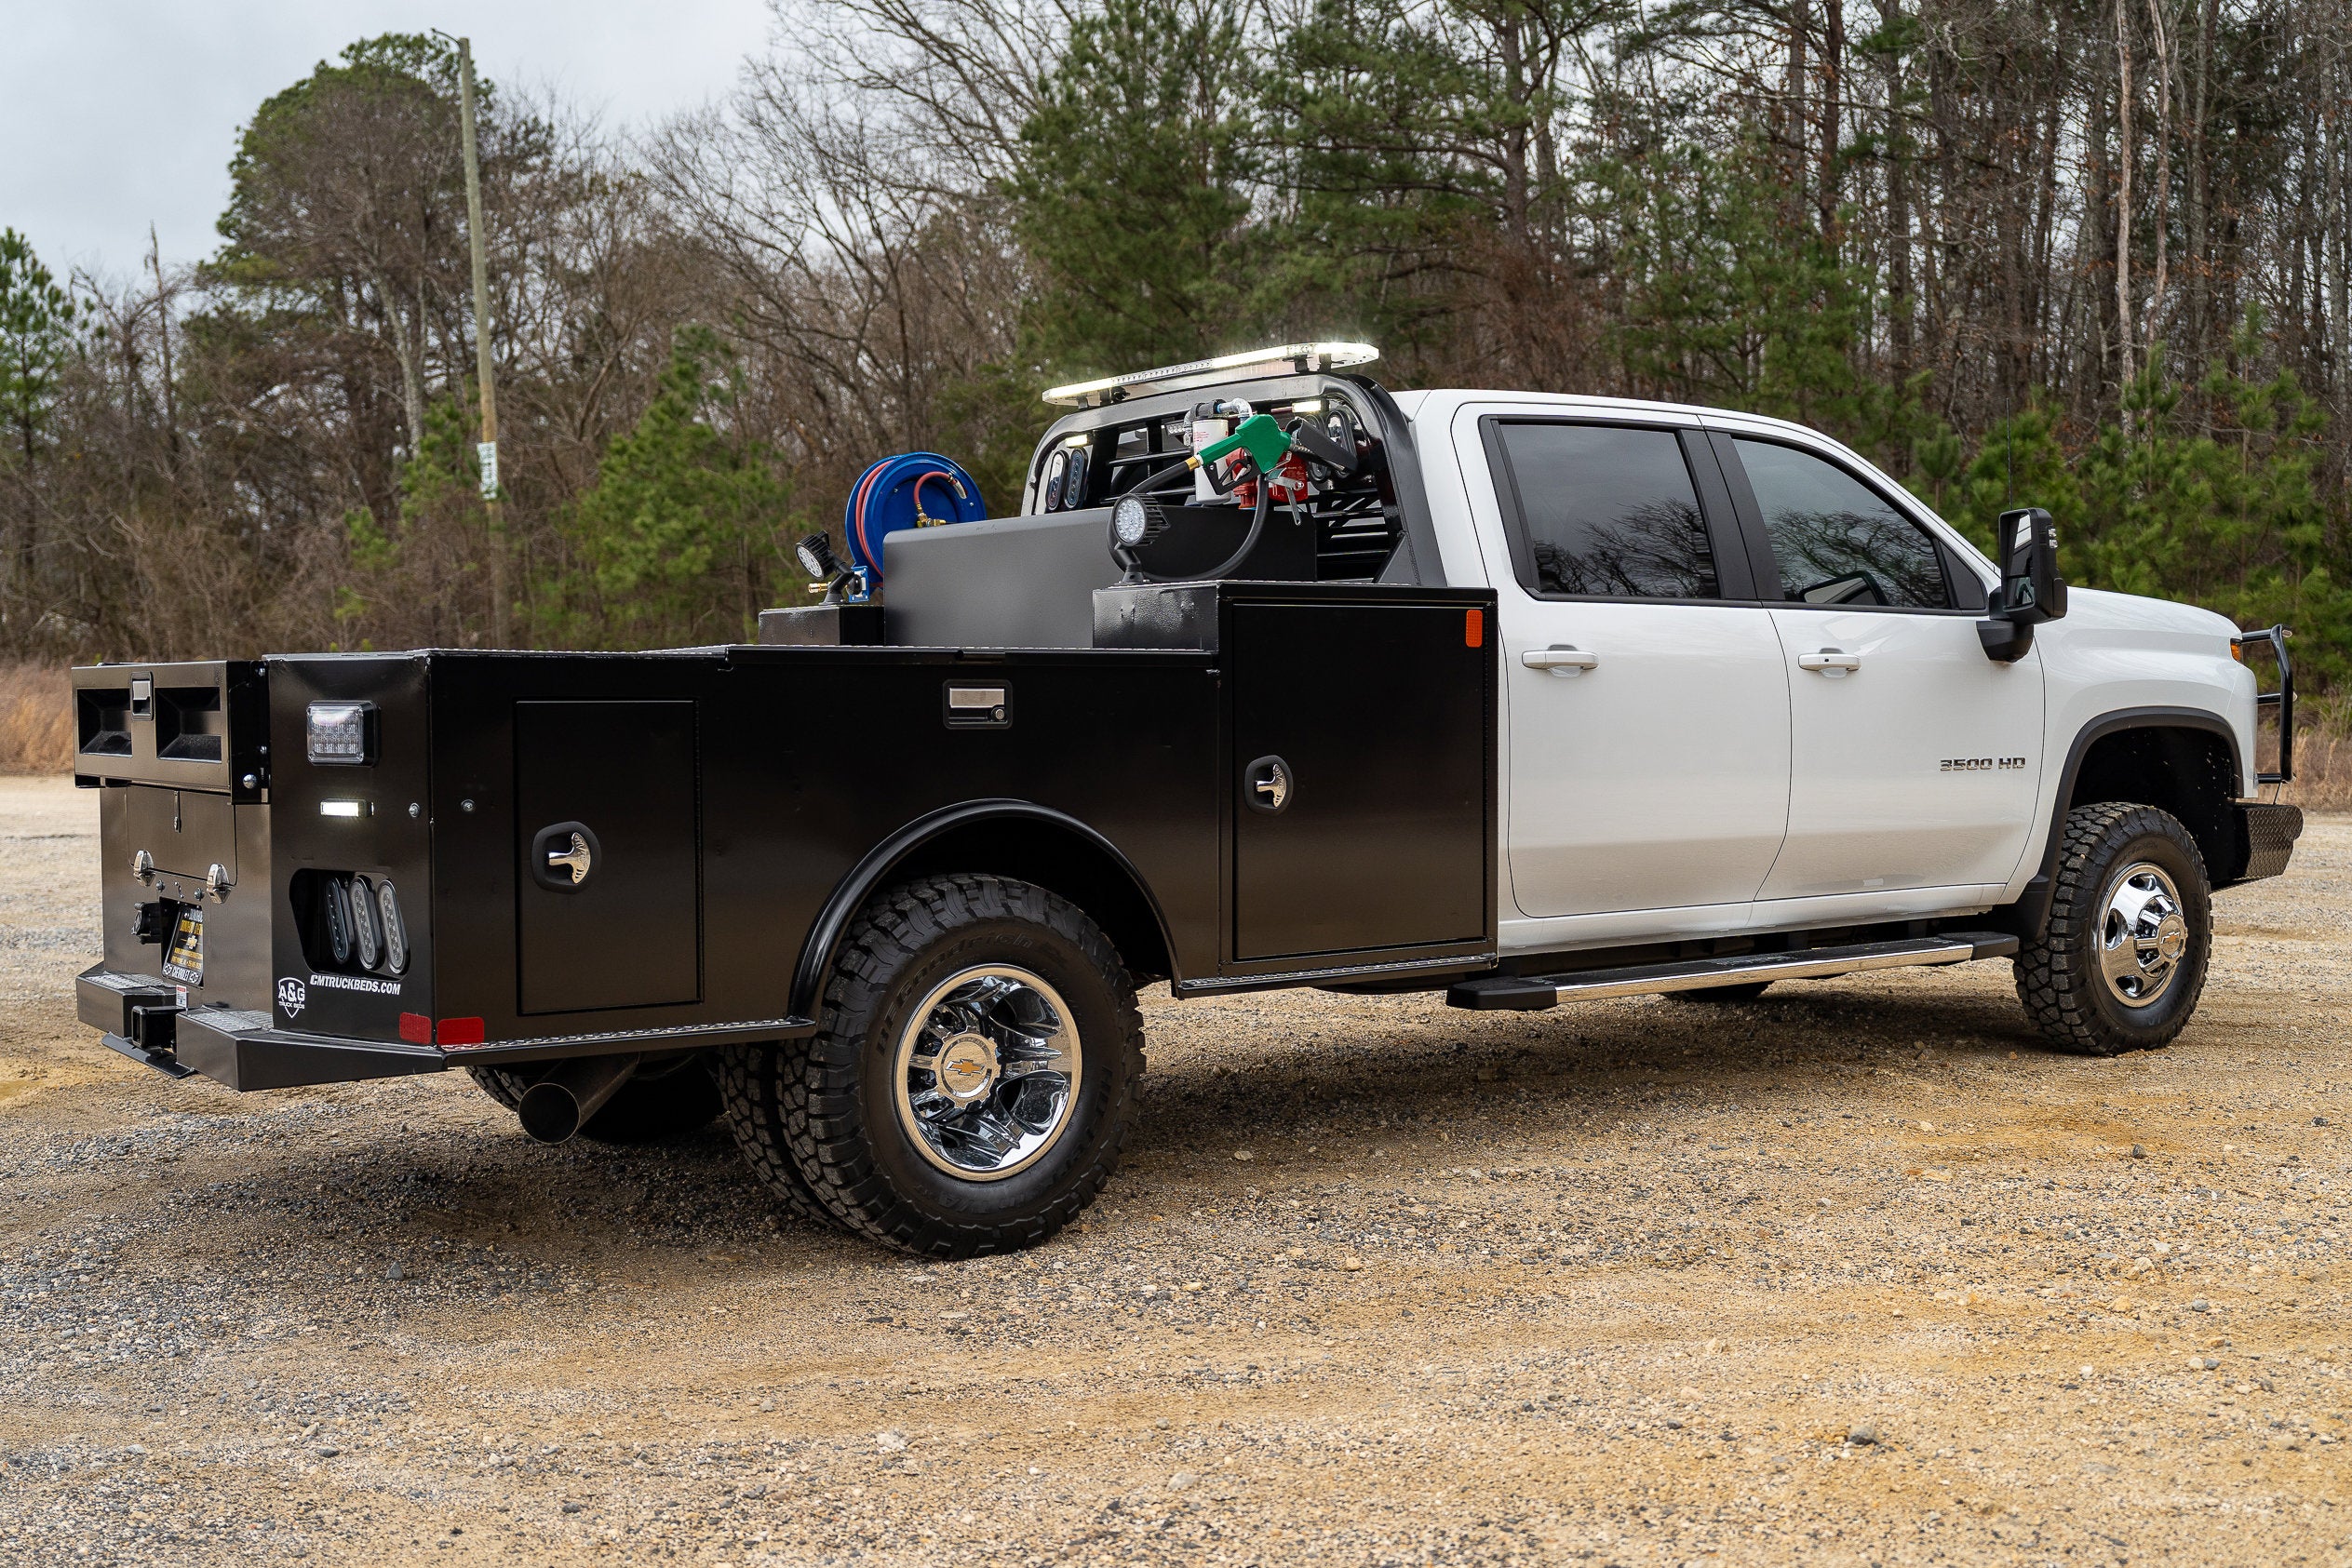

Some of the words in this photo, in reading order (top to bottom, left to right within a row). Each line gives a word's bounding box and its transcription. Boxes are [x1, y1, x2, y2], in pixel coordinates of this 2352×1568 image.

[1940, 758, 1993, 771] 3500
[1998, 757, 2026, 770] HD
[278, 982, 305, 1002] A&G
[309, 974, 401, 996] CMTRUCKBEDS.COM
